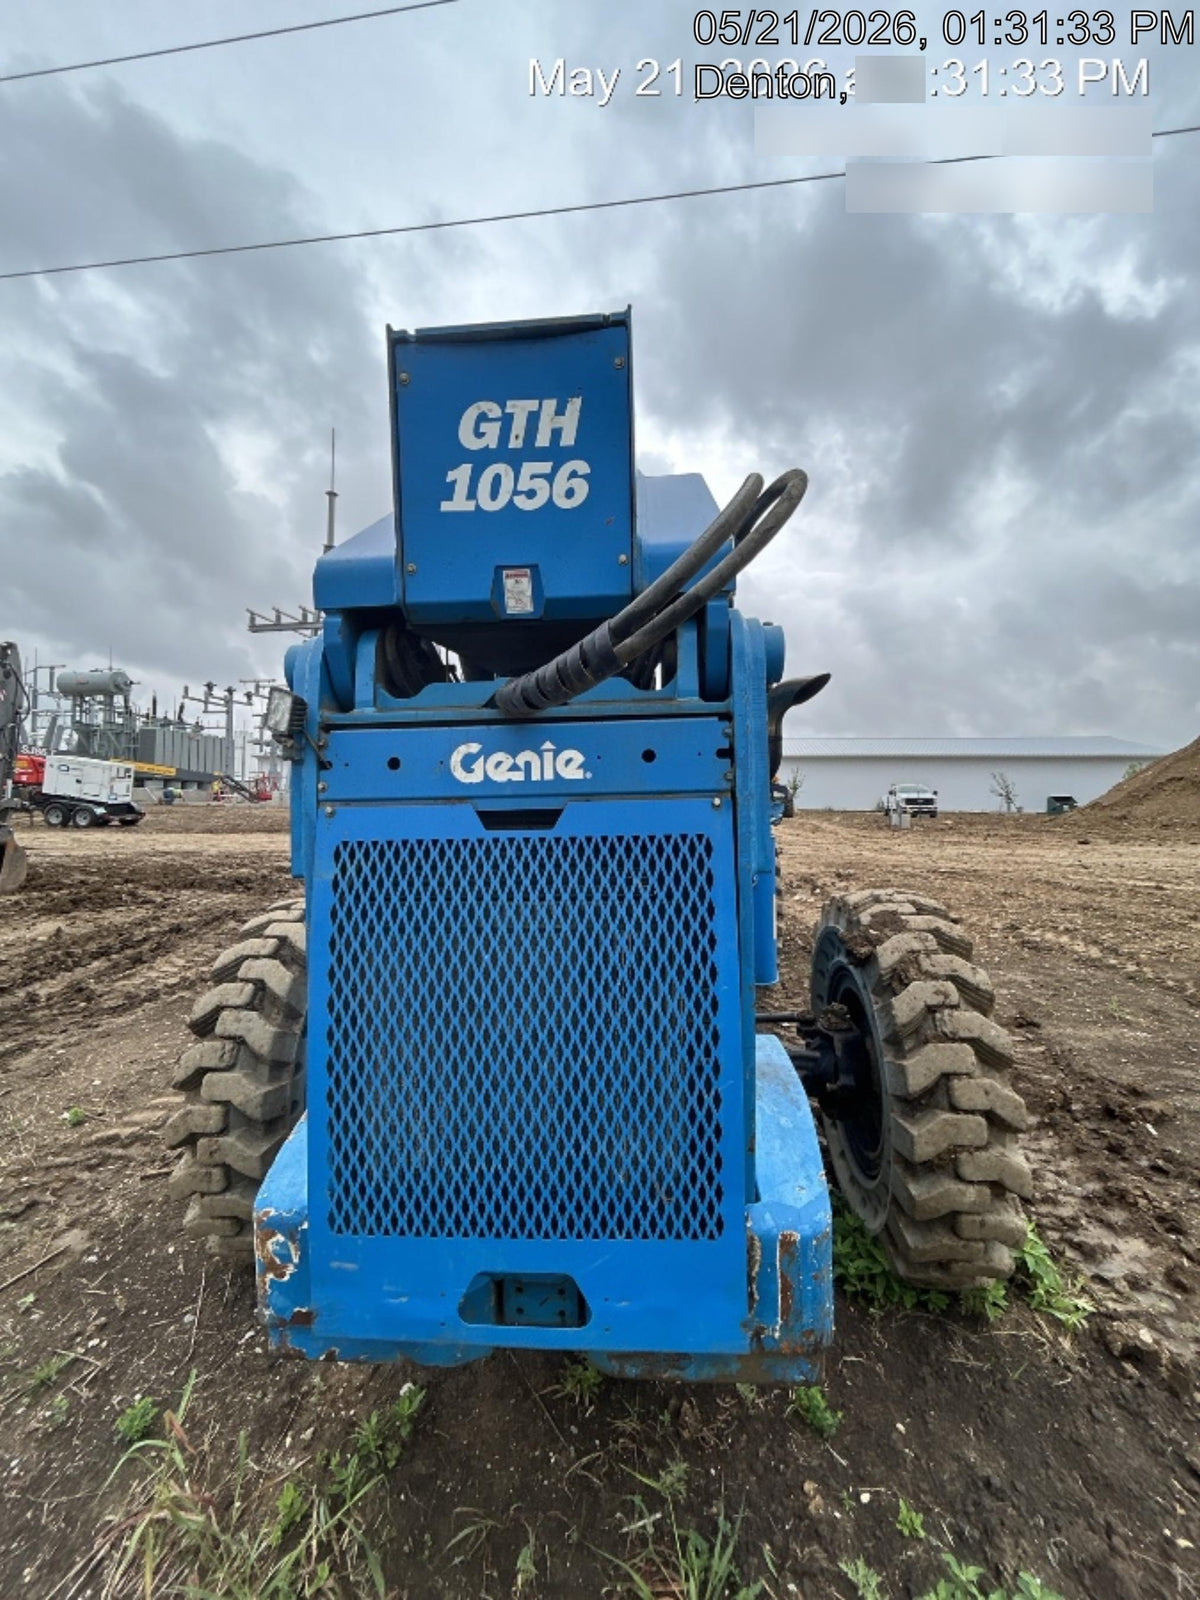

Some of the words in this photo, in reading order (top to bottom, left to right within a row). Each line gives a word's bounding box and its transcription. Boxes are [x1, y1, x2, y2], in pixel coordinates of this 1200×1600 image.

[458, 396, 582, 450] GTH
[440, 460, 591, 512] 1056
[450, 740, 586, 784] Genie
